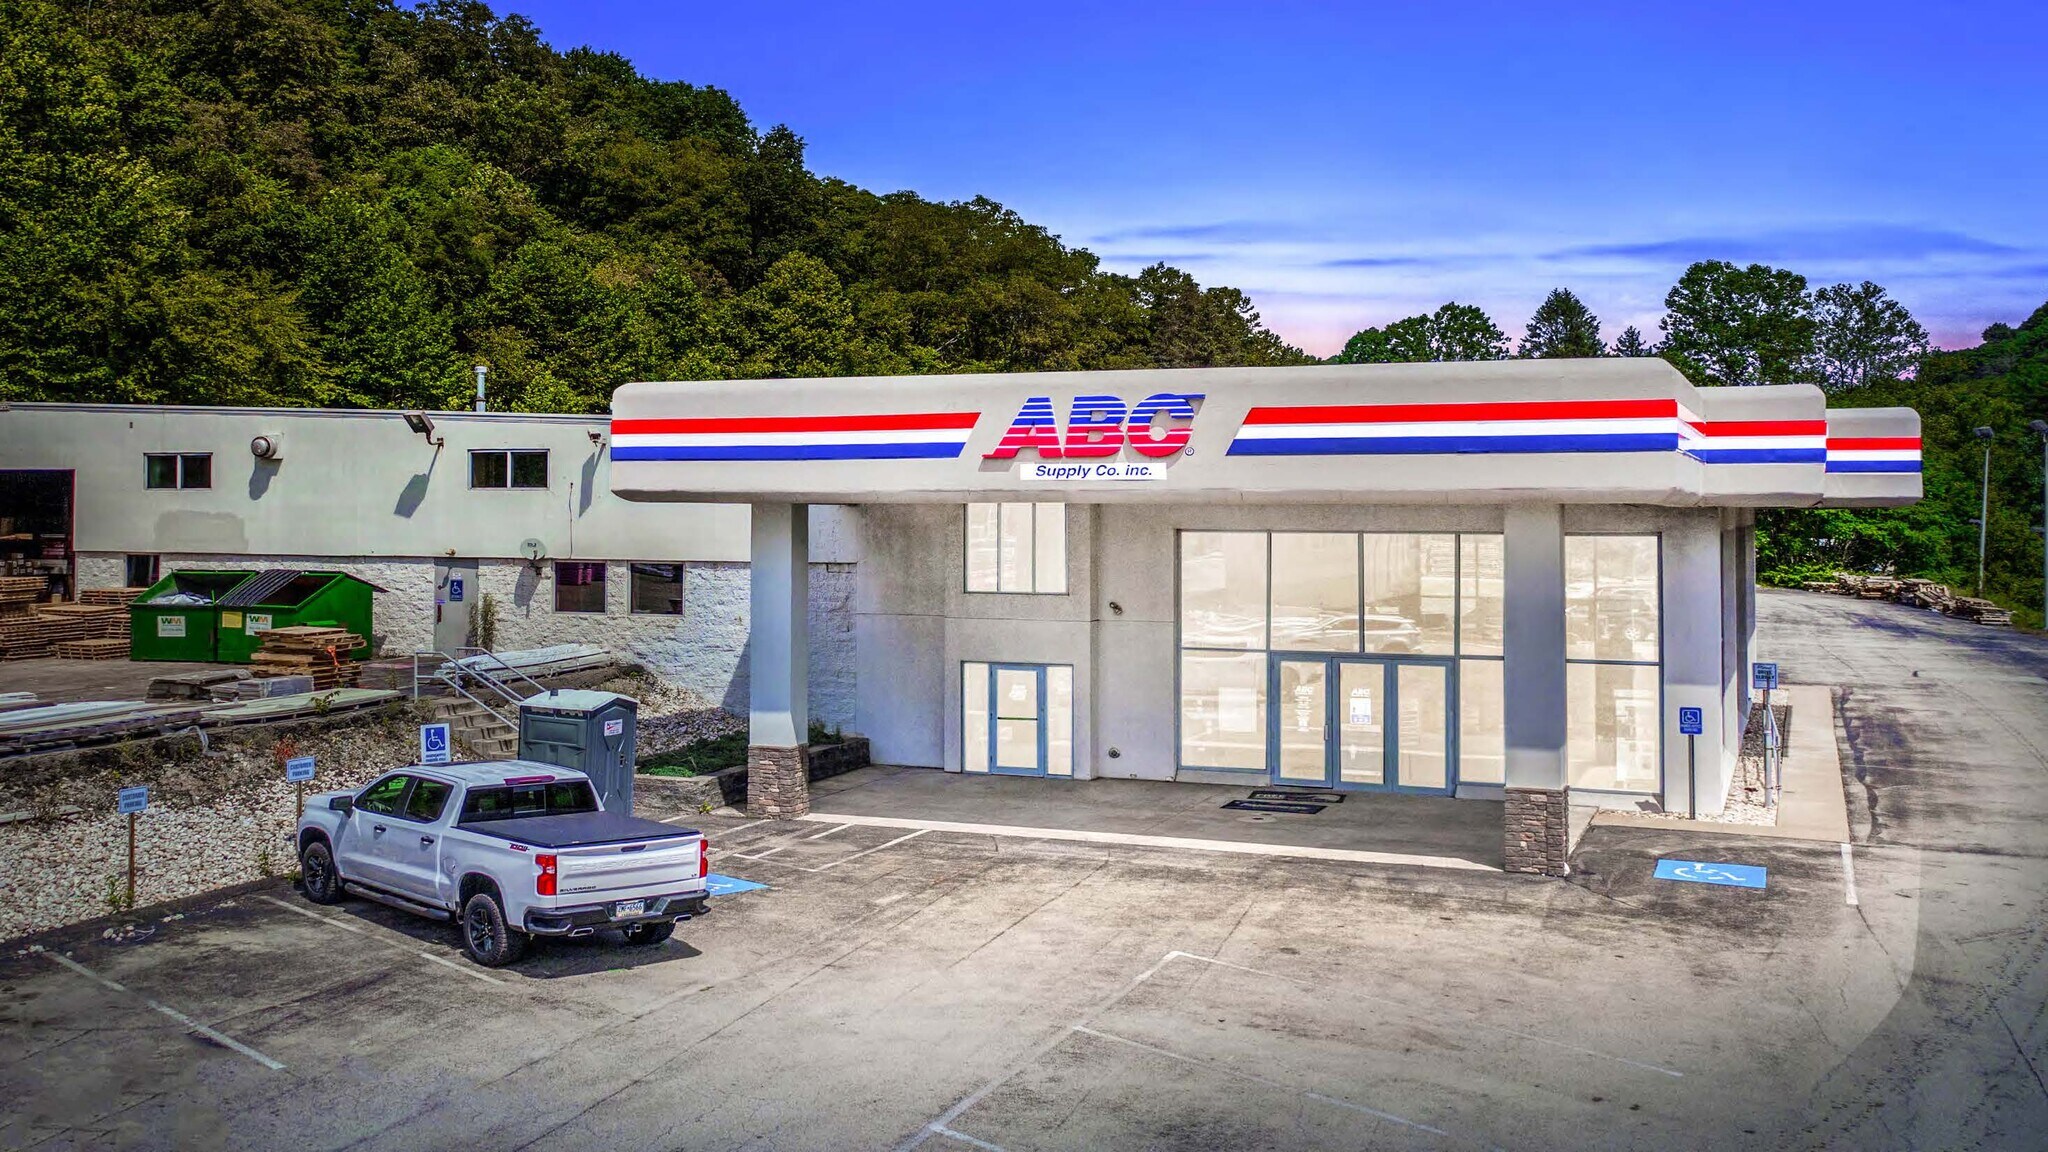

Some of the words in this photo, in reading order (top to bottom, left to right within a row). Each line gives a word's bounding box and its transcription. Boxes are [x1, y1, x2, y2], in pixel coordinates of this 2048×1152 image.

[981, 393, 1206, 458] ABC
[1035, 464, 1091, 479] Supply
[1096, 464, 1121, 477] Co.
[1125, 464, 1153, 476] inc.
